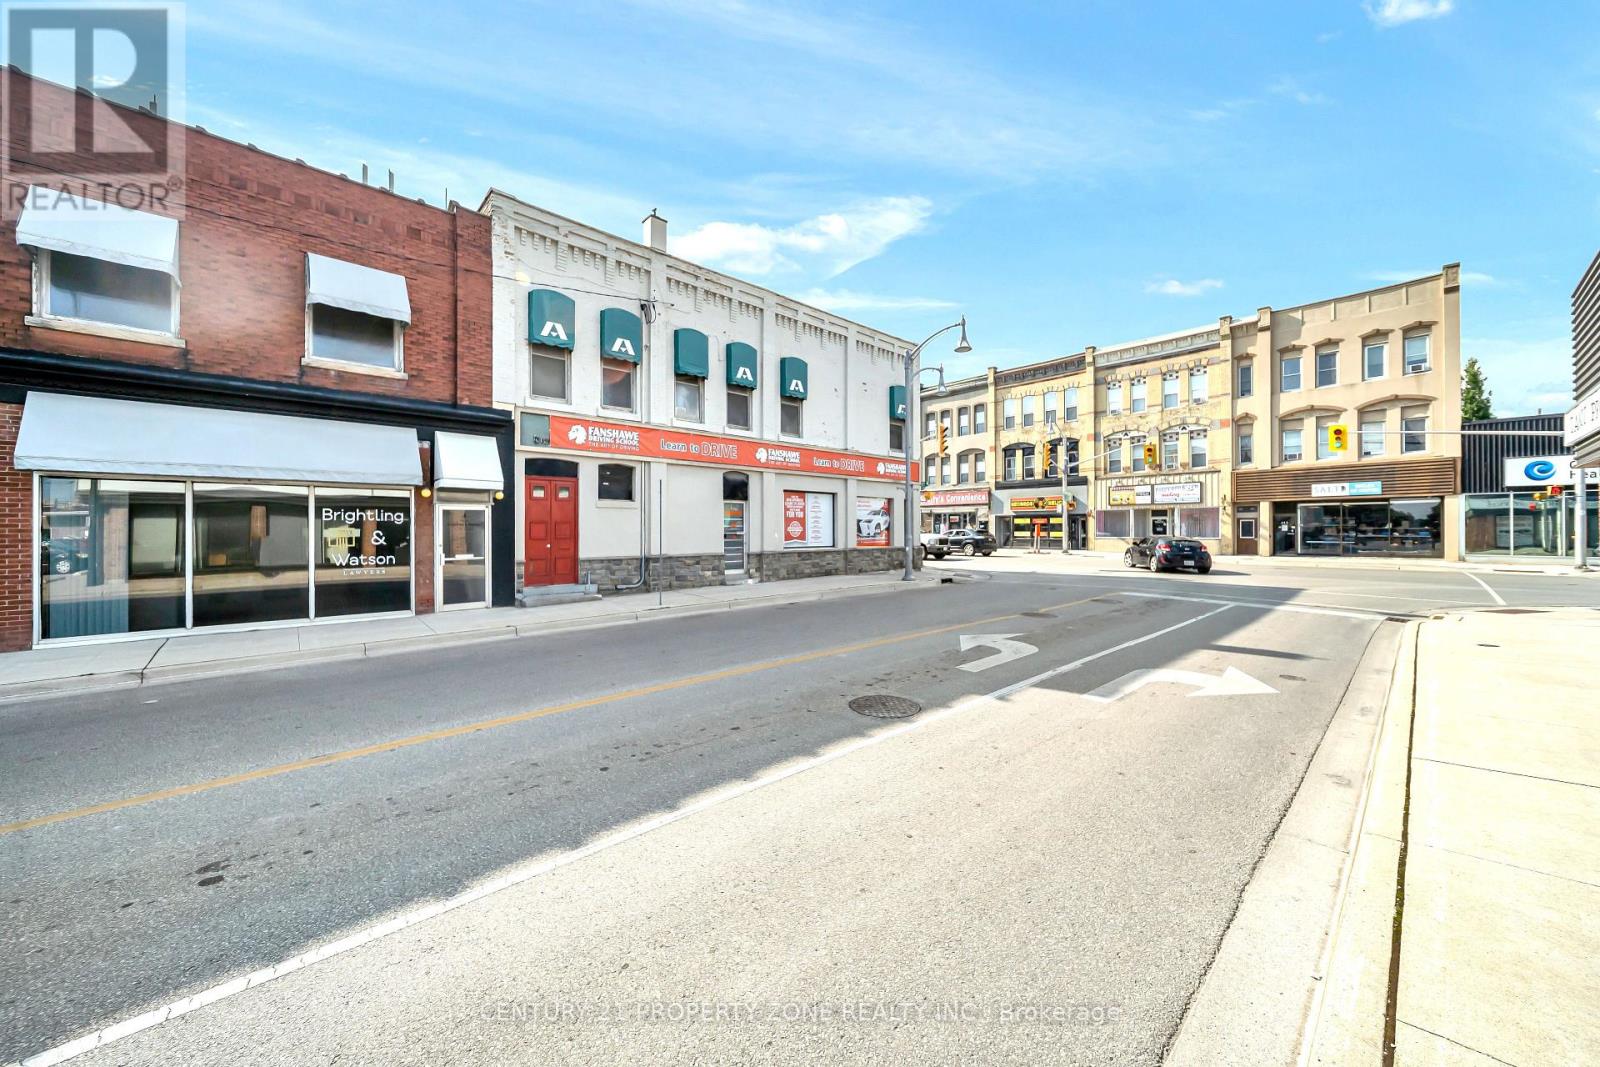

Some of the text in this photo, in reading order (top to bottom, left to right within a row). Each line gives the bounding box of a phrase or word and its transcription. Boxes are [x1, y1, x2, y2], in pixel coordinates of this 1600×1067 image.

[588, 426, 640, 441] FANSHAWE
[588, 435, 639, 447] DRIVING SCHOOL
[660, 439, 738, 459] Learn to DRIVE
[768, 448, 801, 459] FANSHAWE
[813, 456, 832, 467] Learn
[832, 459, 840, 469] to
[840, 458, 865, 472] DRIVE
[945, 493, 987, 503] Convenience
[322, 508, 404, 525] Brightling
[371, 530, 387, 546] &
[331, 553, 396, 567] Watson
